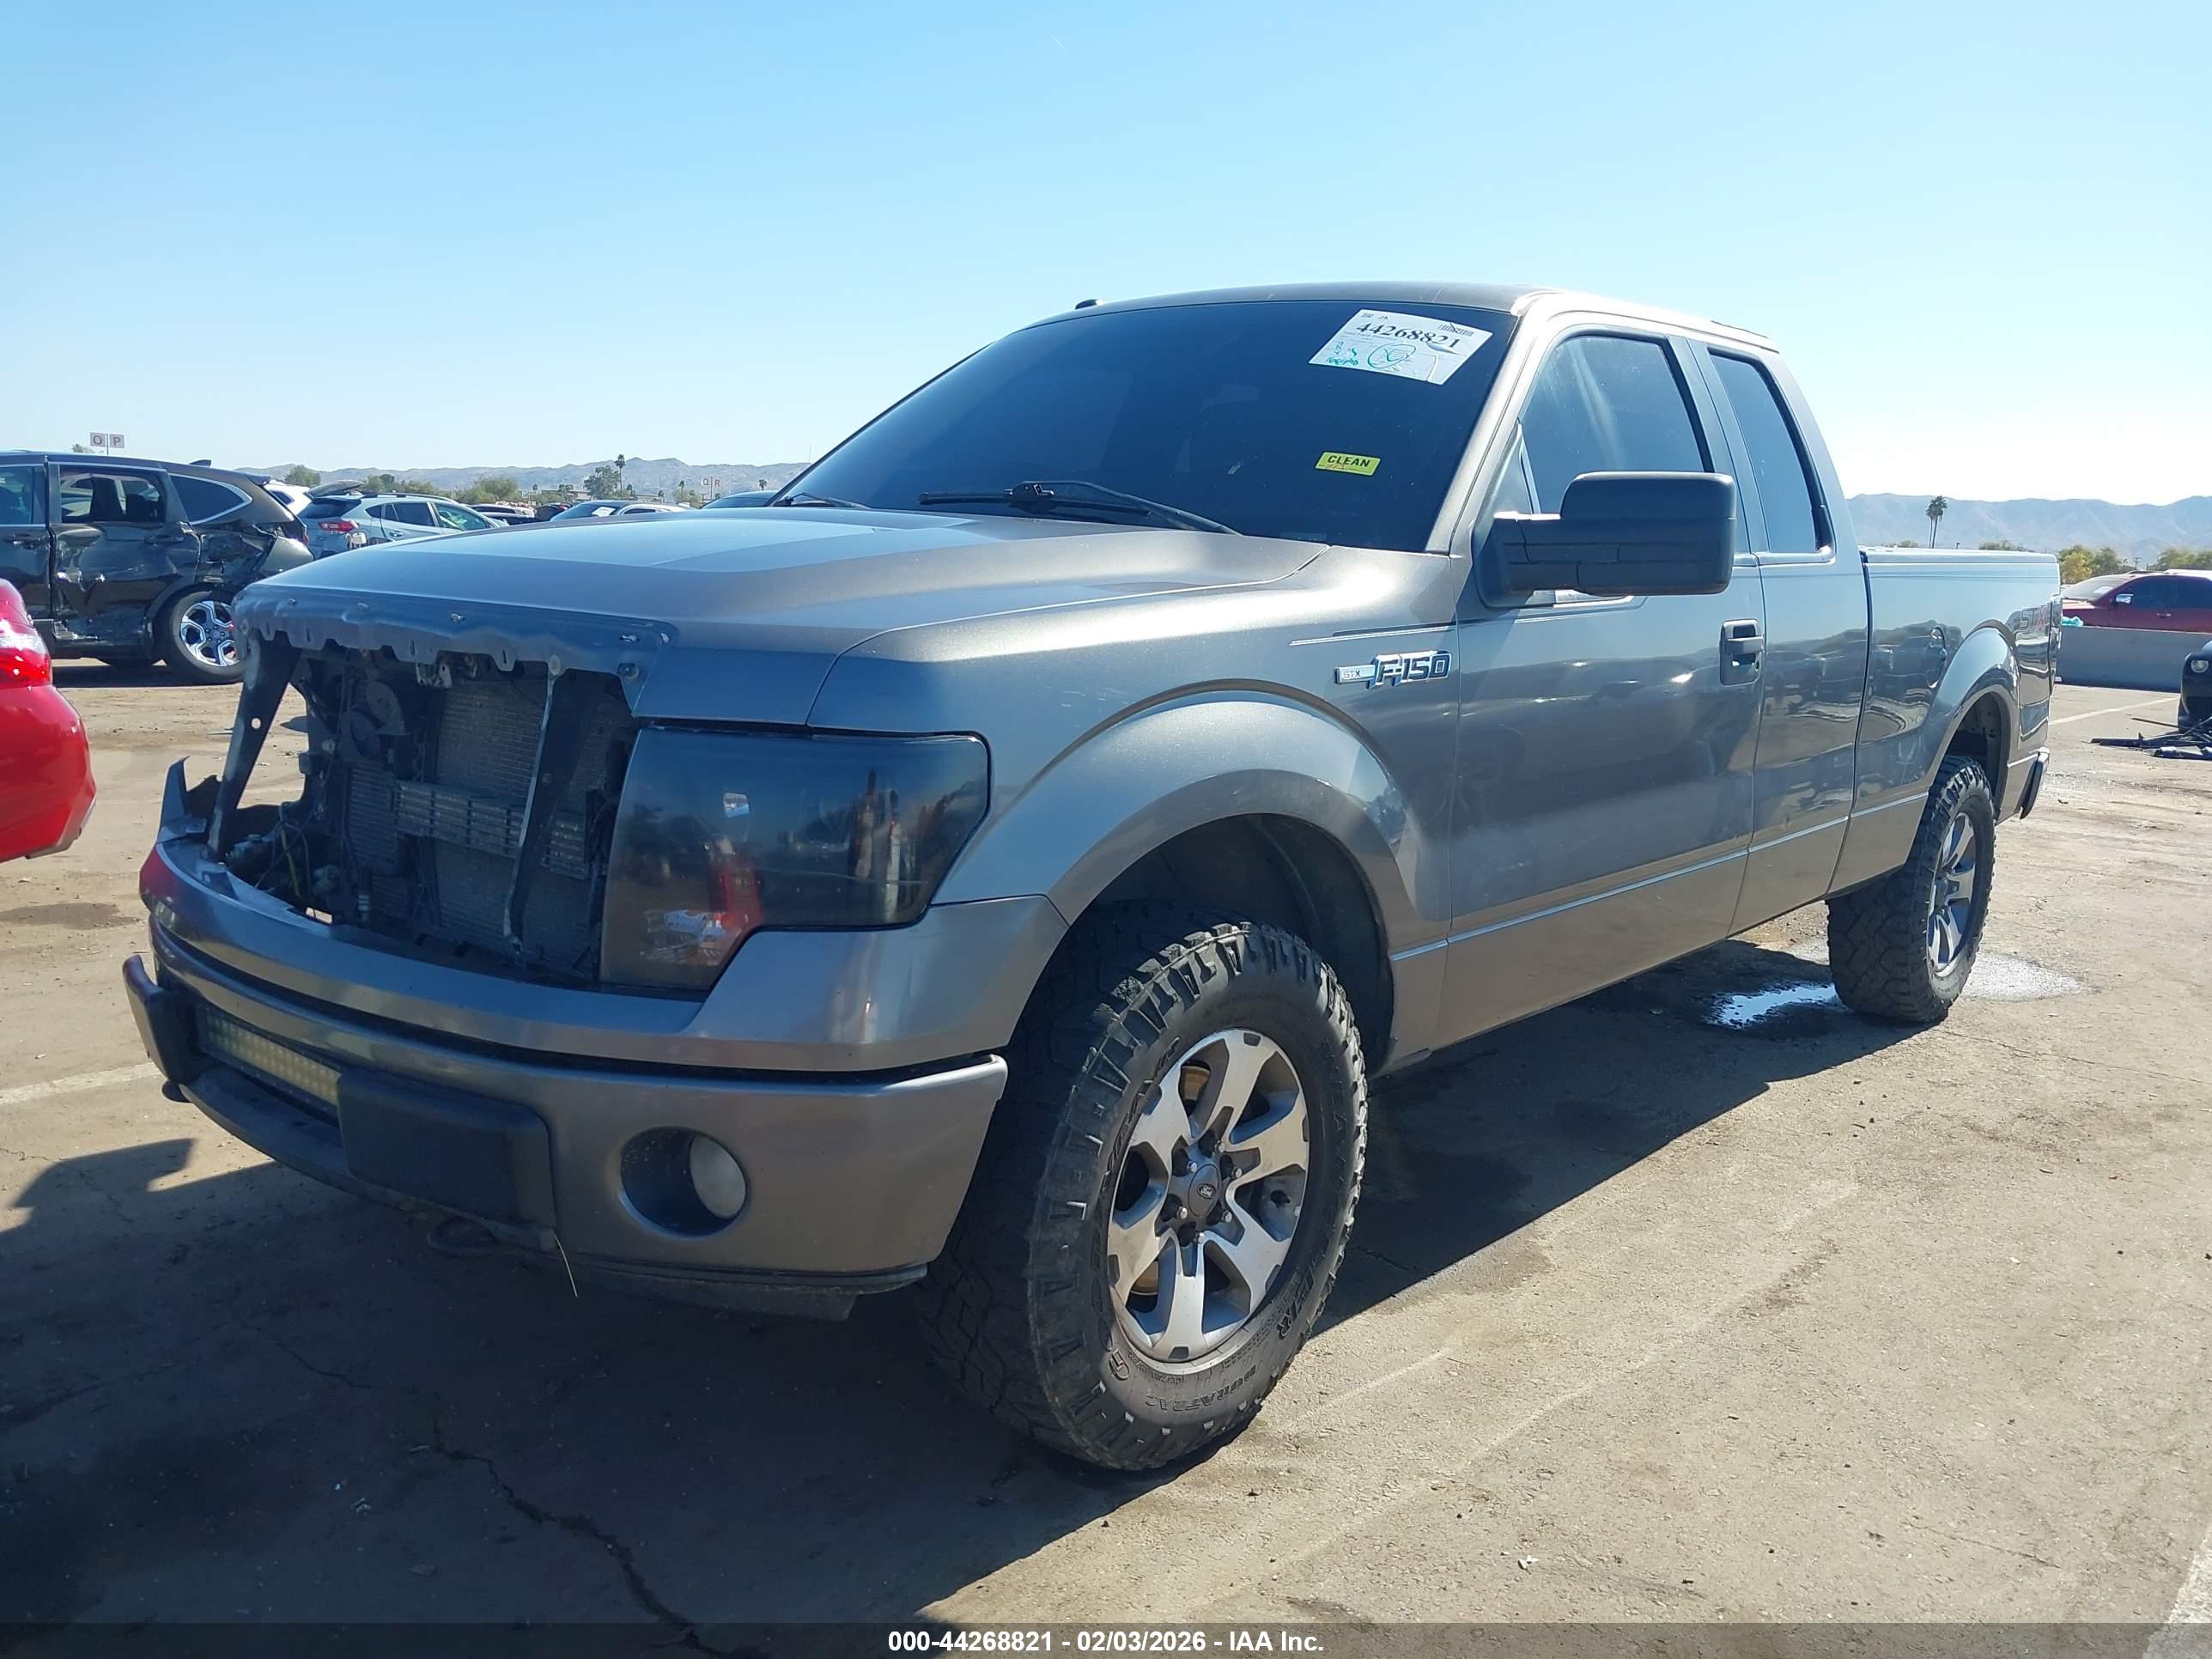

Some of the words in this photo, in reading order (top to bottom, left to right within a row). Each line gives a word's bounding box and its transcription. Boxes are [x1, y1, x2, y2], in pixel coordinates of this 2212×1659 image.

[1356, 322, 1461, 349] 44268821
[93, 435, 102, 445] O
[113, 436, 121, 446] P
[1327, 454, 1370, 468] CLEAN
[1343, 670, 1361, 679] STX
[1373, 651, 1452, 687] F-150
